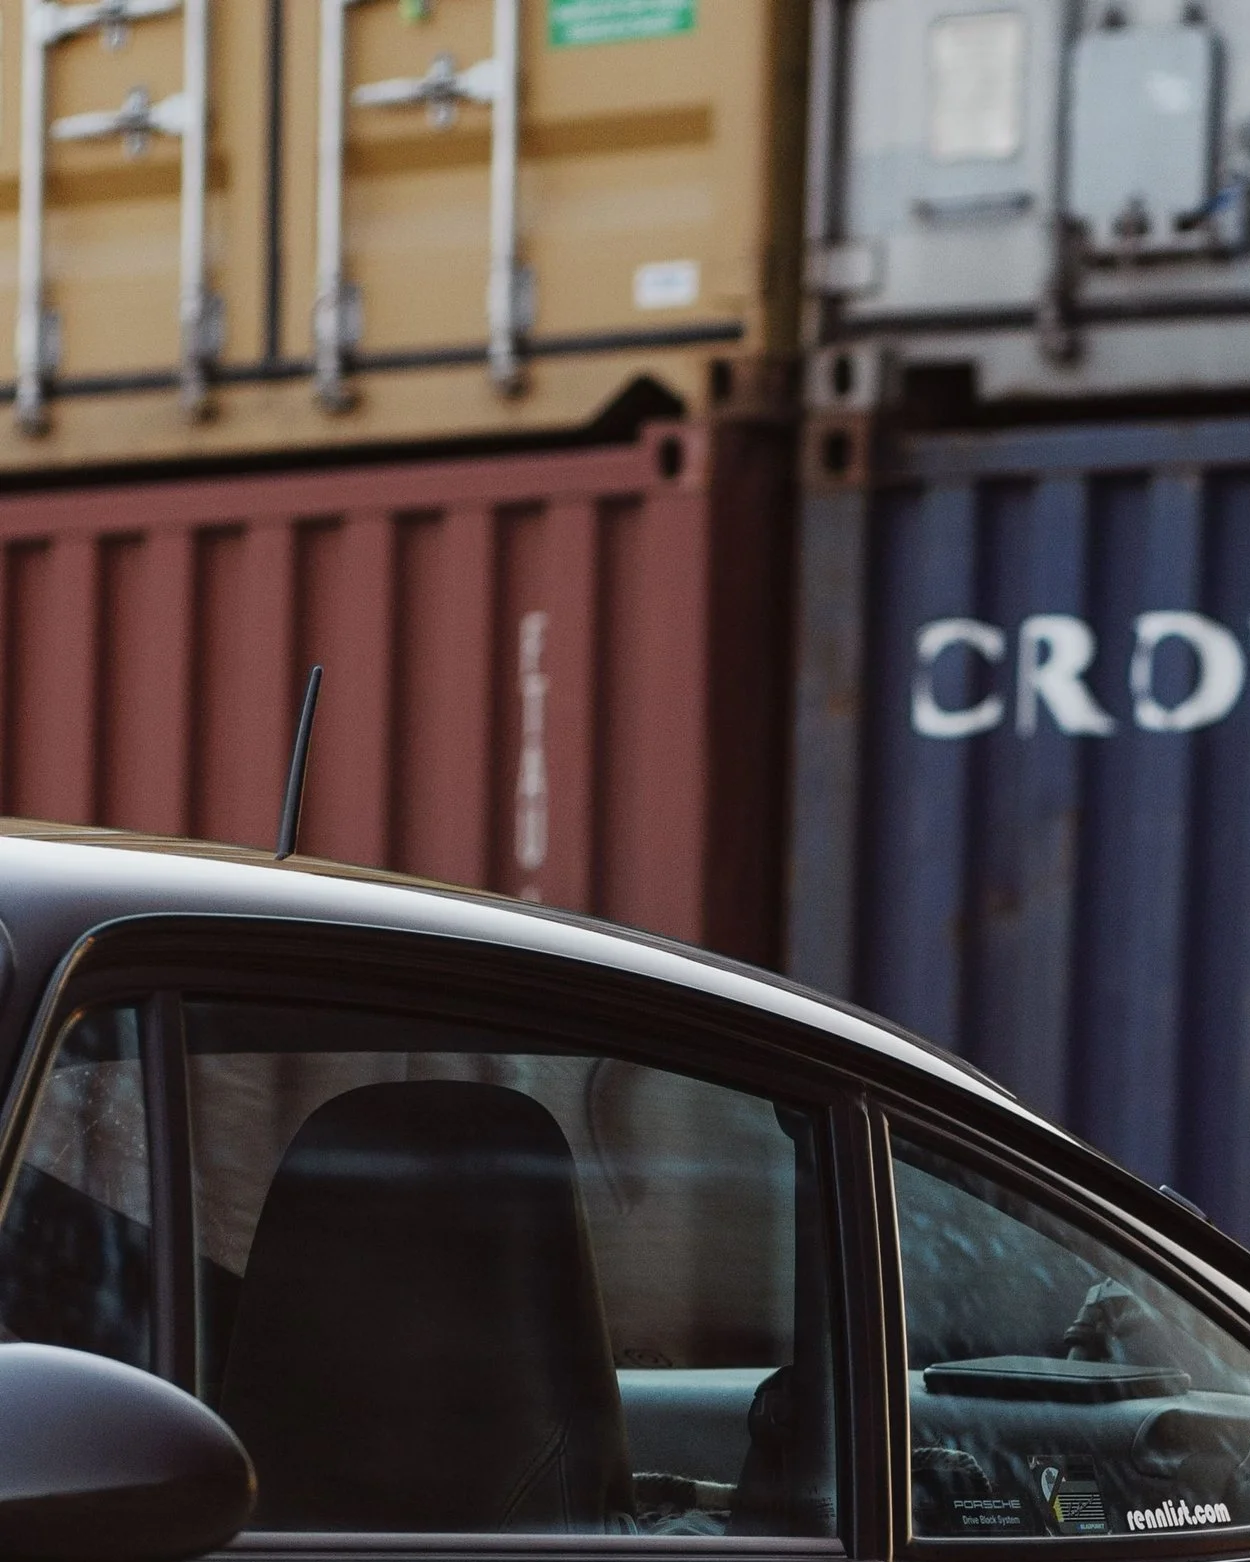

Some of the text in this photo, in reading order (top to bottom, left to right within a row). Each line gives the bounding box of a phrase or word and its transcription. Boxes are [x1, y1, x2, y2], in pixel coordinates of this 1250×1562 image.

[953, 1499, 1022, 1510] PORSCHE
[962, 1515, 978, 1526] Drive
[998, 1515, 1021, 1528] System
[1127, 1499, 1232, 1531] rennlist.com
